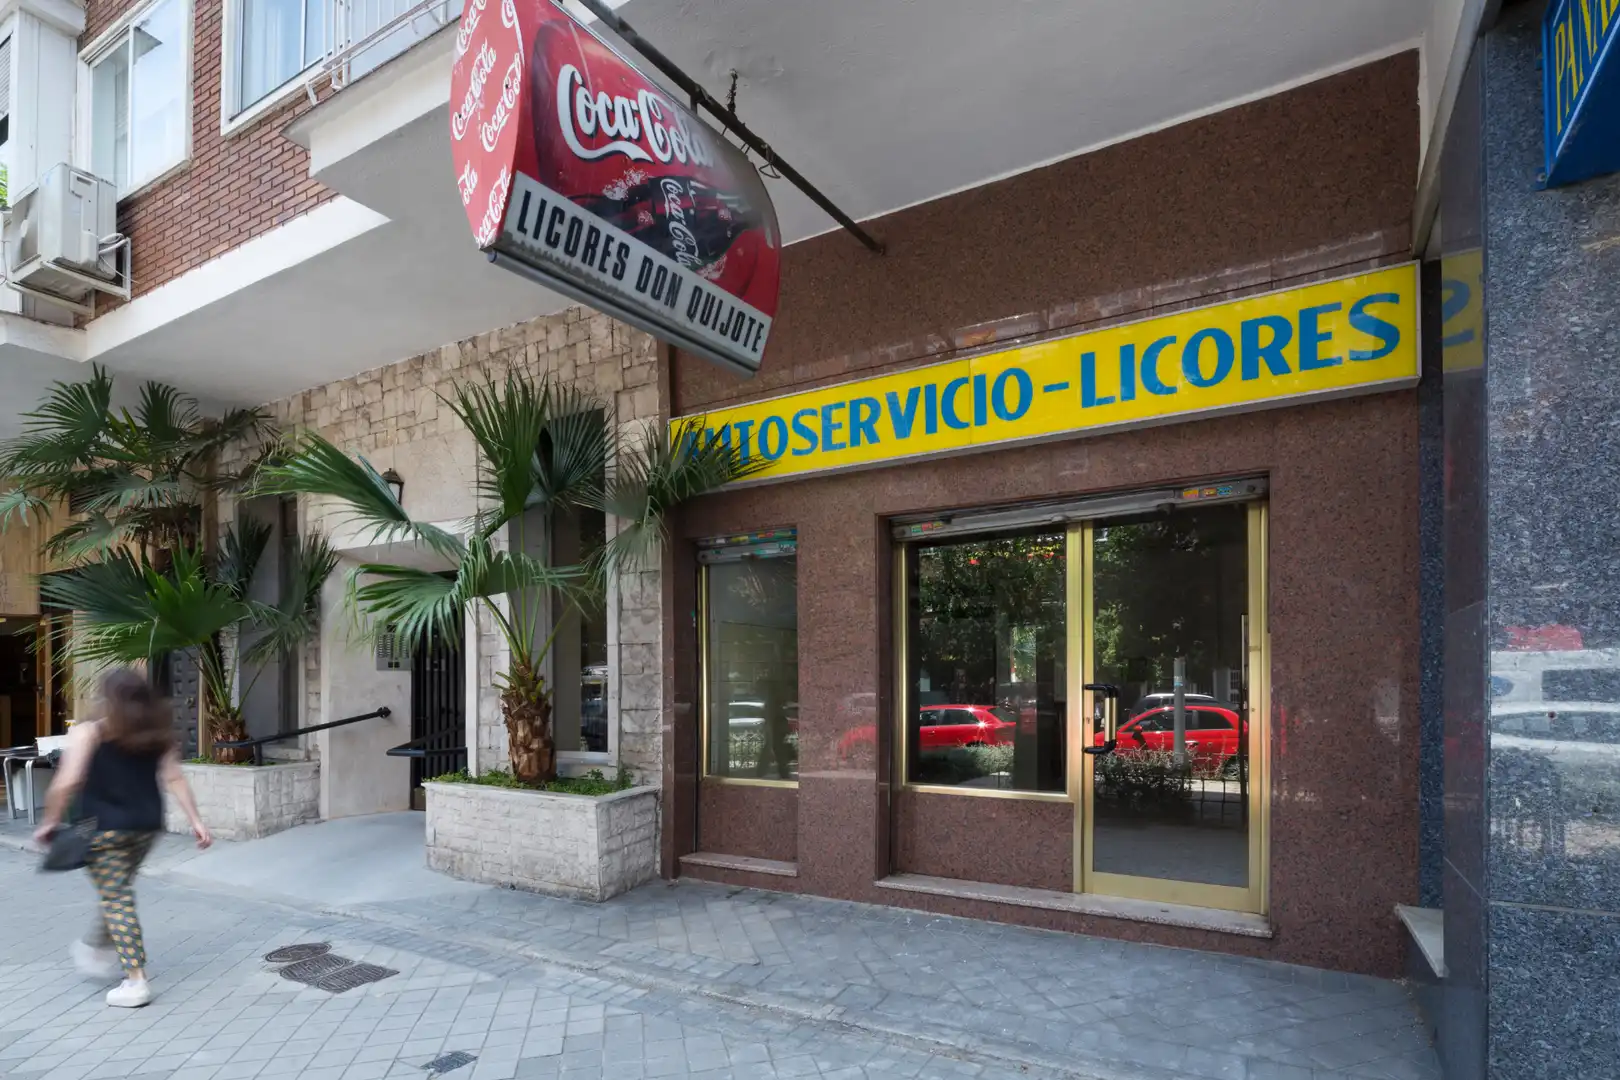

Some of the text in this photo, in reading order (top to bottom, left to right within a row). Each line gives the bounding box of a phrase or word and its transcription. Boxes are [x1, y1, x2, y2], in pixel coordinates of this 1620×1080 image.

[557, 64, 714, 167] Coca-Cola
[517, 190, 631, 281] LICORES
[635, 255, 683, 310] DON
[686, 285, 764, 353] QUIJOTE
